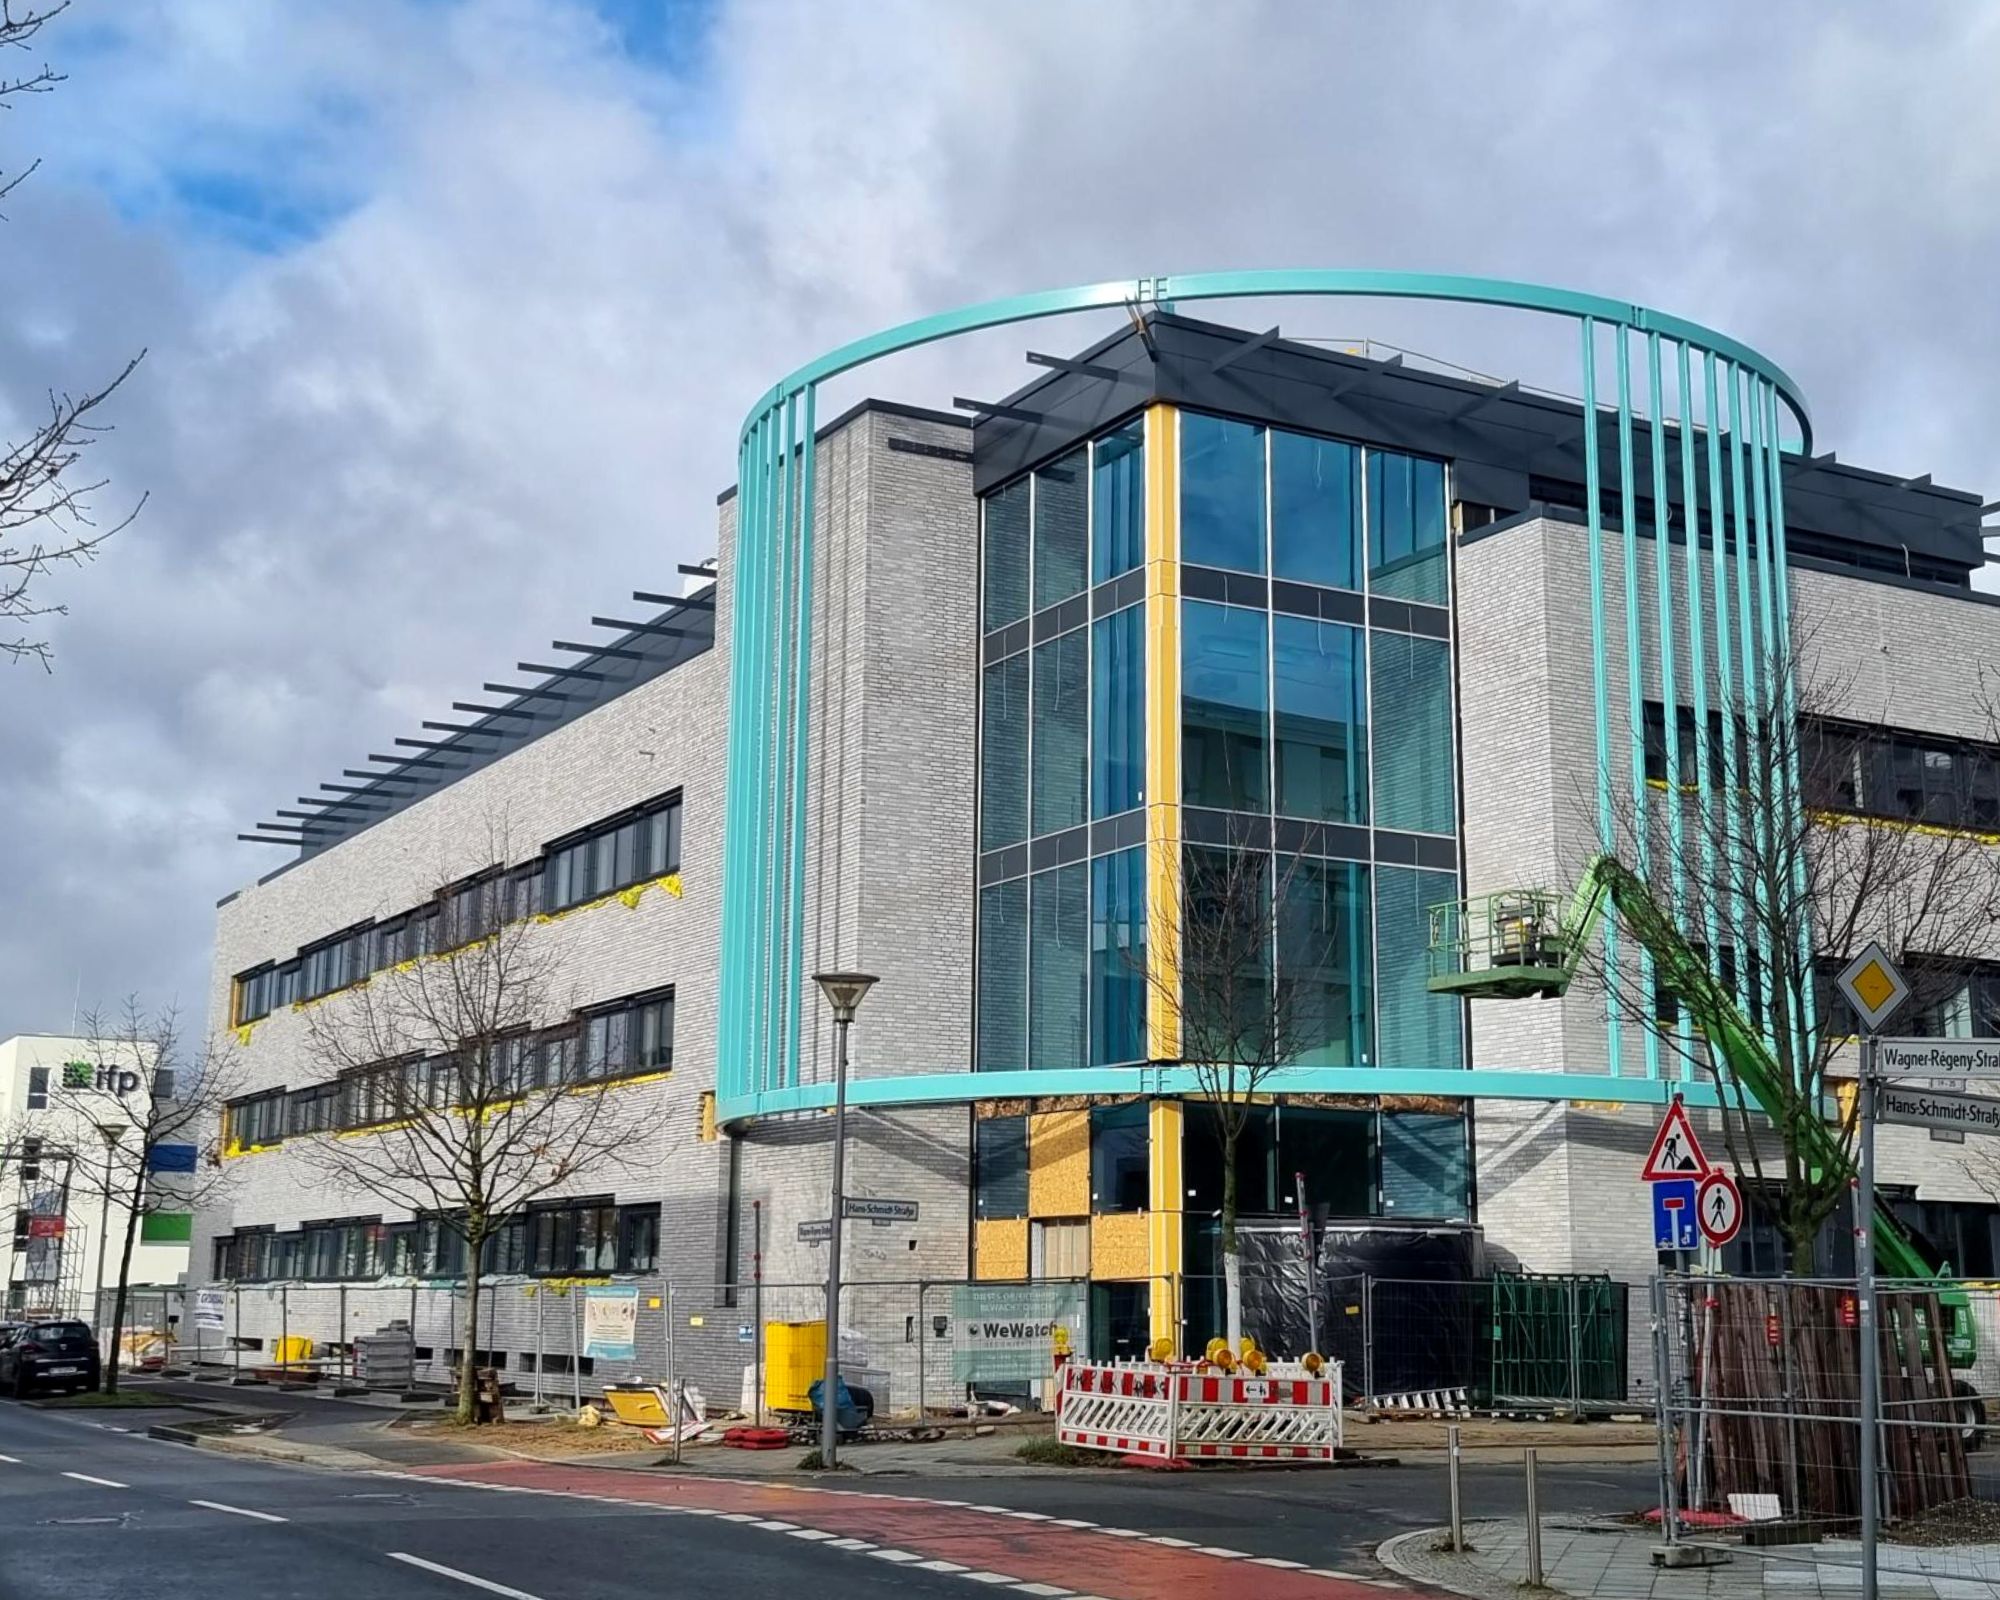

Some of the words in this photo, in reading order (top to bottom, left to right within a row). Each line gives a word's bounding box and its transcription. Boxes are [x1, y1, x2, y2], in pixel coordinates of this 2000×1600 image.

[1884, 1048, 2000, 1071] Wagner-Régeny-Stra
[96, 1063, 140, 1097] ifp
[1886, 1095, 2000, 1128] Hans-Schmidt-Straß
[983, 1320, 1058, 1339] WeWatch
